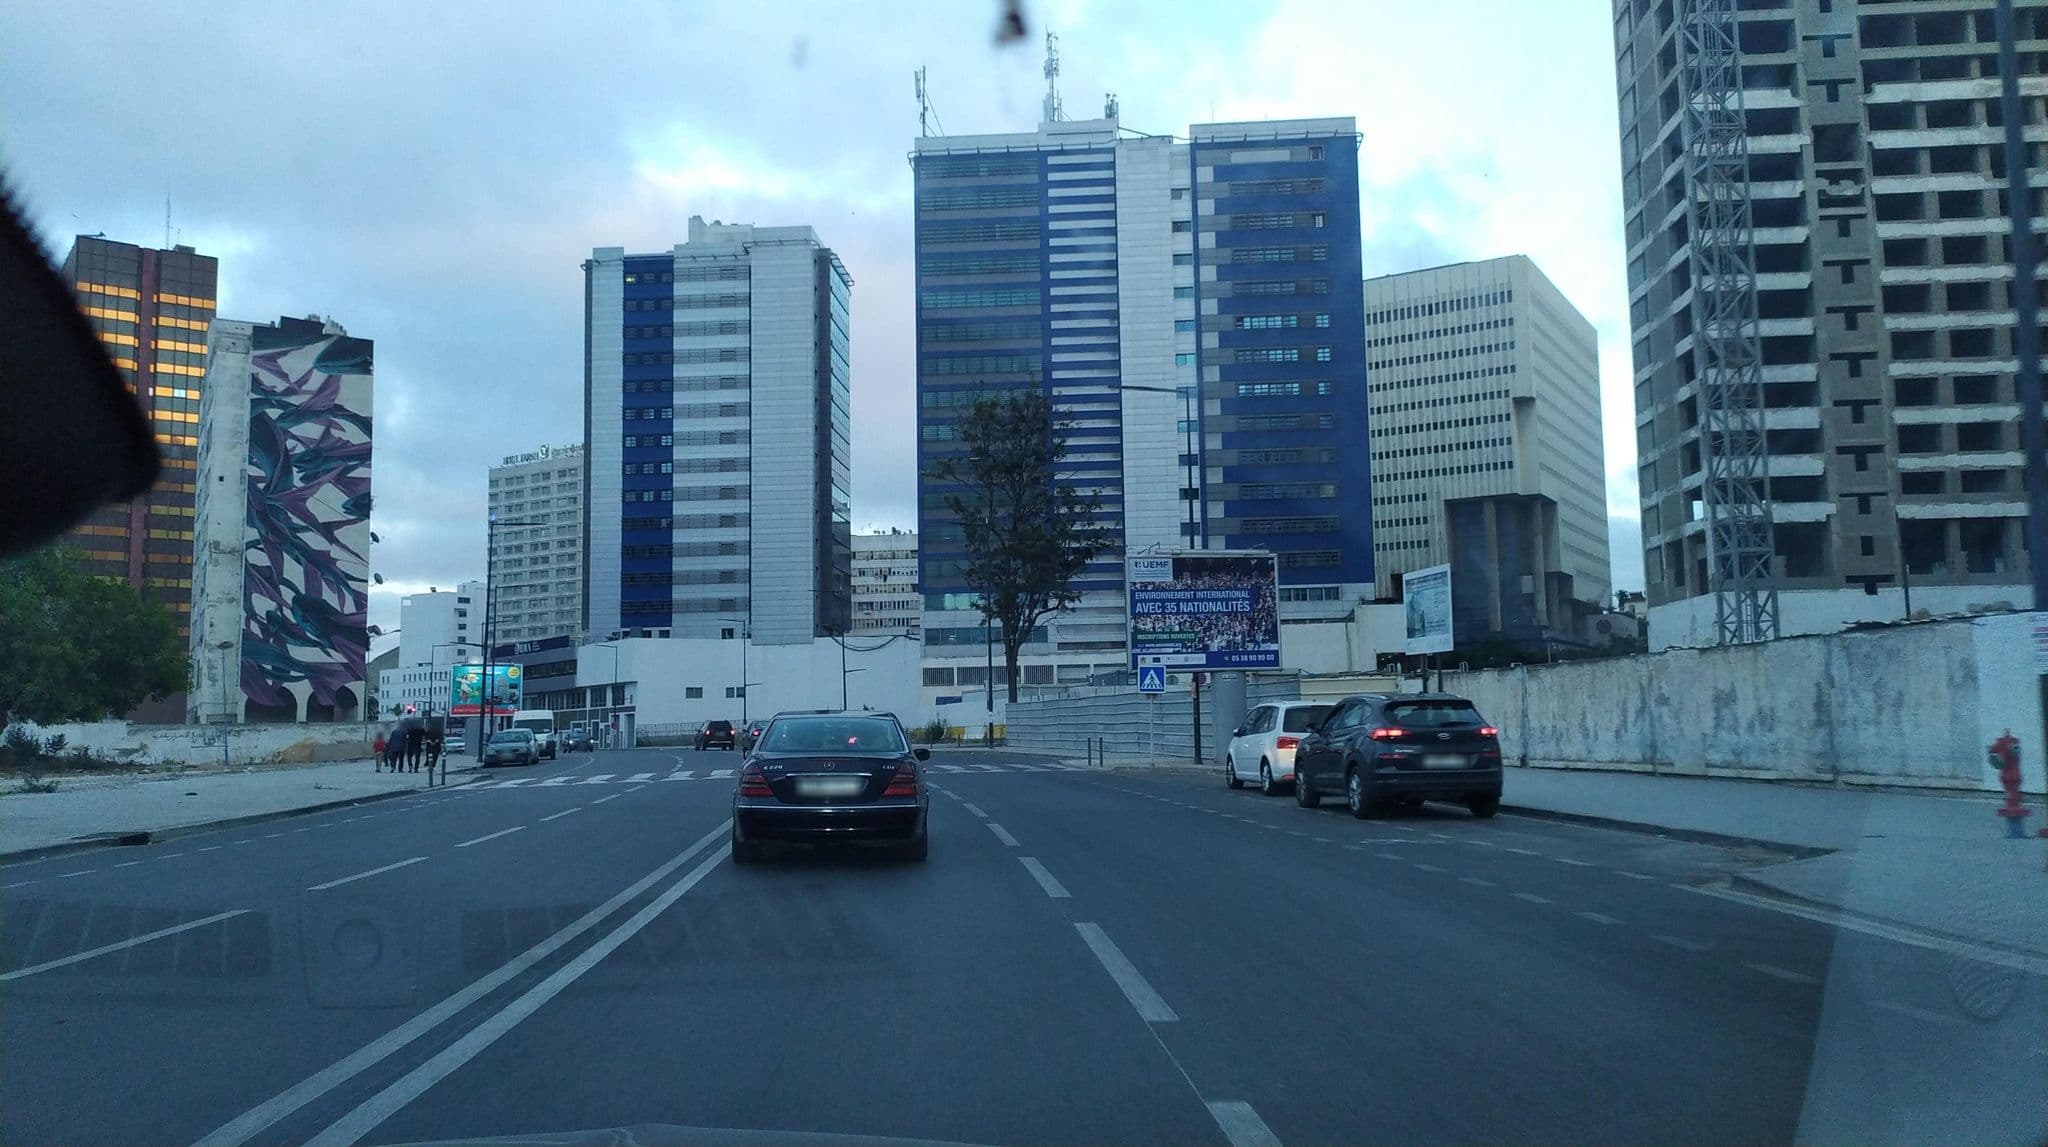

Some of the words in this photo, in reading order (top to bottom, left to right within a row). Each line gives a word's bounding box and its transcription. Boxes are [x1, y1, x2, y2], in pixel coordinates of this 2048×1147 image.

[1143, 561, 1169, 569] UEMF
[1135, 591, 1195, 600] ENVIRONNEMENT
[1196, 590, 1250, 599] INTERNATIONAL
[1135, 602, 1162, 613] AVEC
[1164, 602, 1177, 613] 35
[1179, 599, 1250, 613] NATIONALITÉS
